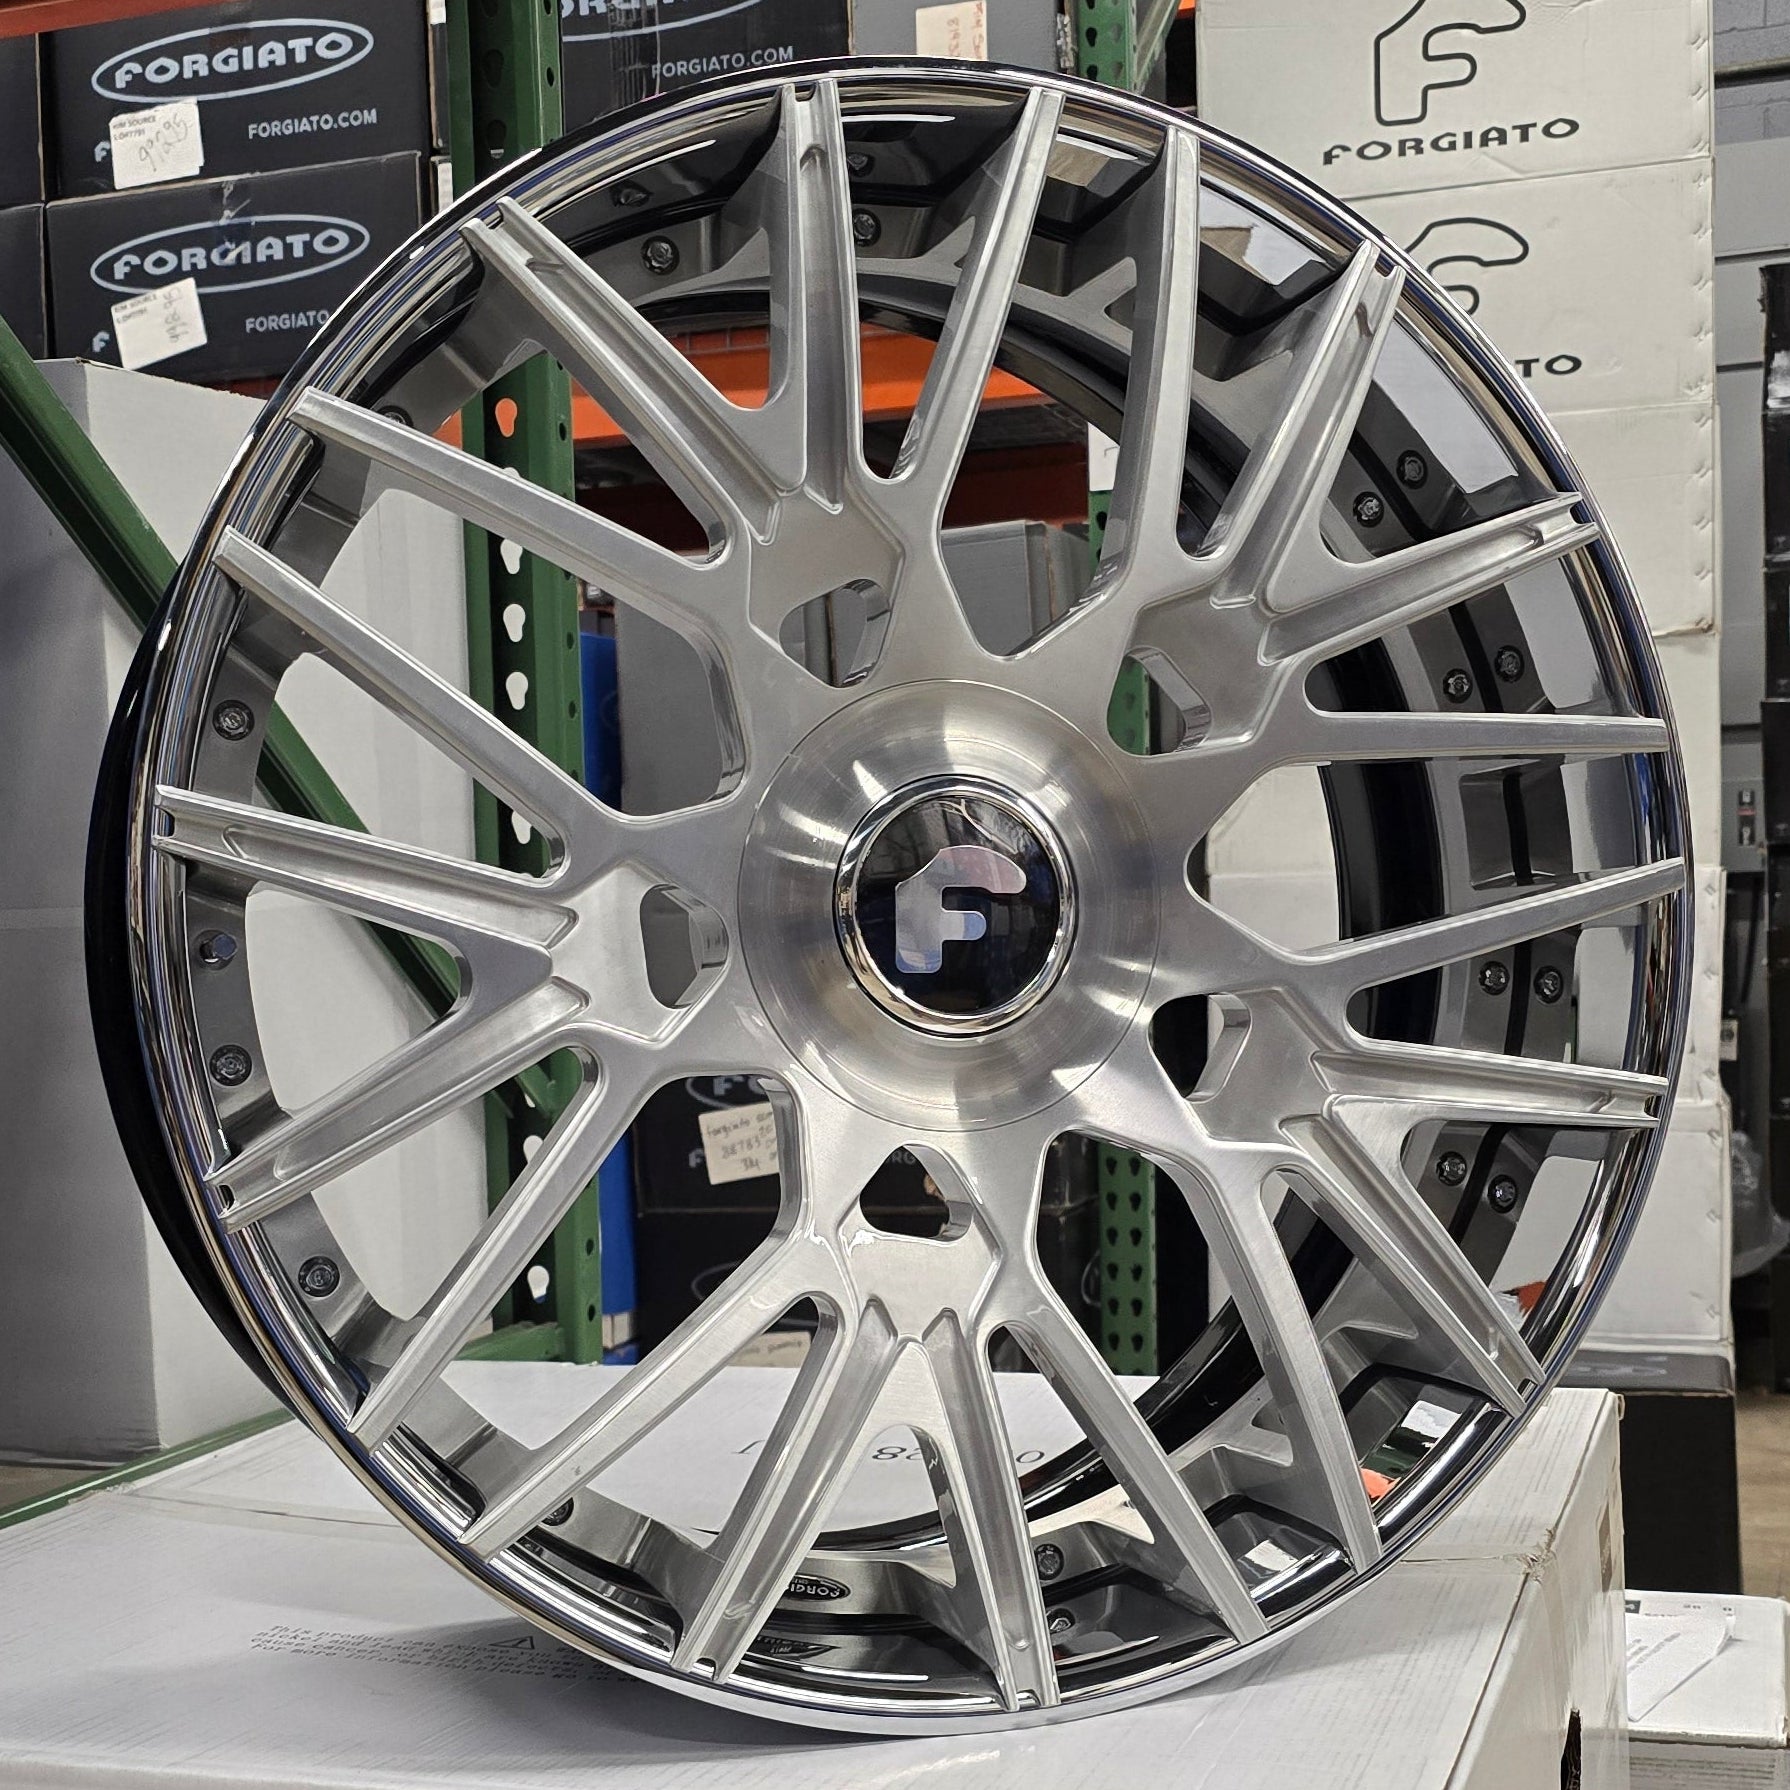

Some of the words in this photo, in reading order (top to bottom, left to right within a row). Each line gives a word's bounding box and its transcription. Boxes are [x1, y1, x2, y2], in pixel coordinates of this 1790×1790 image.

[114, 31, 354, 89] FORGIATO
[651, 46, 794, 79] FORGIATO.COM
[248, 108, 378, 139] FORGIATO.COM
[1322, 118, 1580, 165] FORGIATO
[113, 228, 350, 280] FORGIATO
